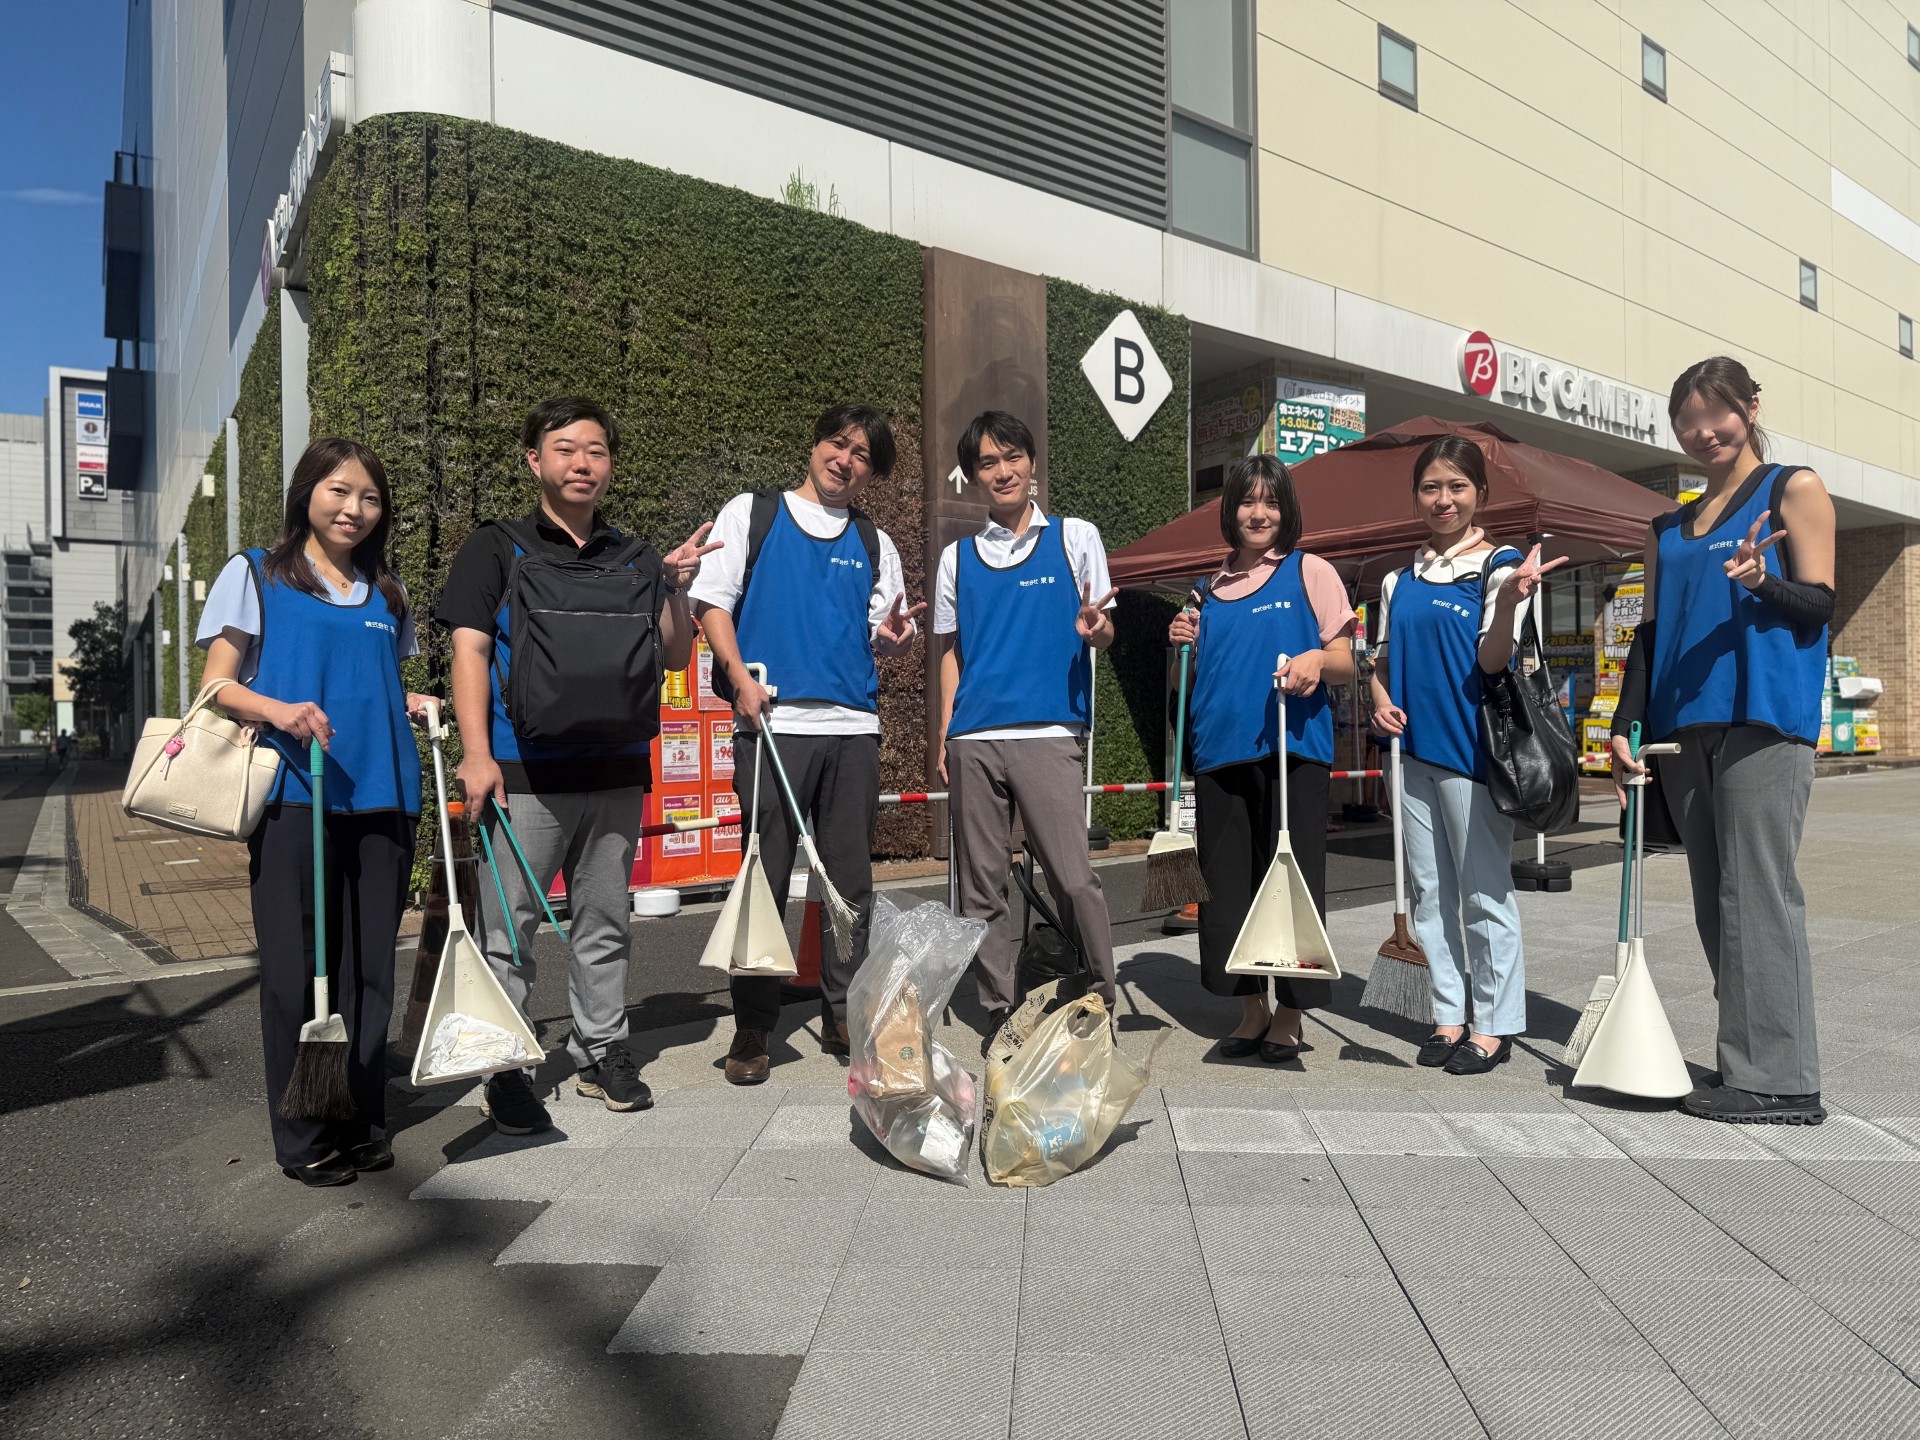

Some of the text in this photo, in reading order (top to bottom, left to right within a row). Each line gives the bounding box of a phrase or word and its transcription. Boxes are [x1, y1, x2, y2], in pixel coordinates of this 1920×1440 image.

[1114, 337, 1145, 404] B
[1501, 351, 1660, 434] BIC CAMERA
[79, 401, 102, 409] IMAX
[1279, 402, 1326, 419] 省エネラベル
[80, 476, 94, 492] P
[715, 724, 730, 732] au
[715, 796, 730, 804] au
